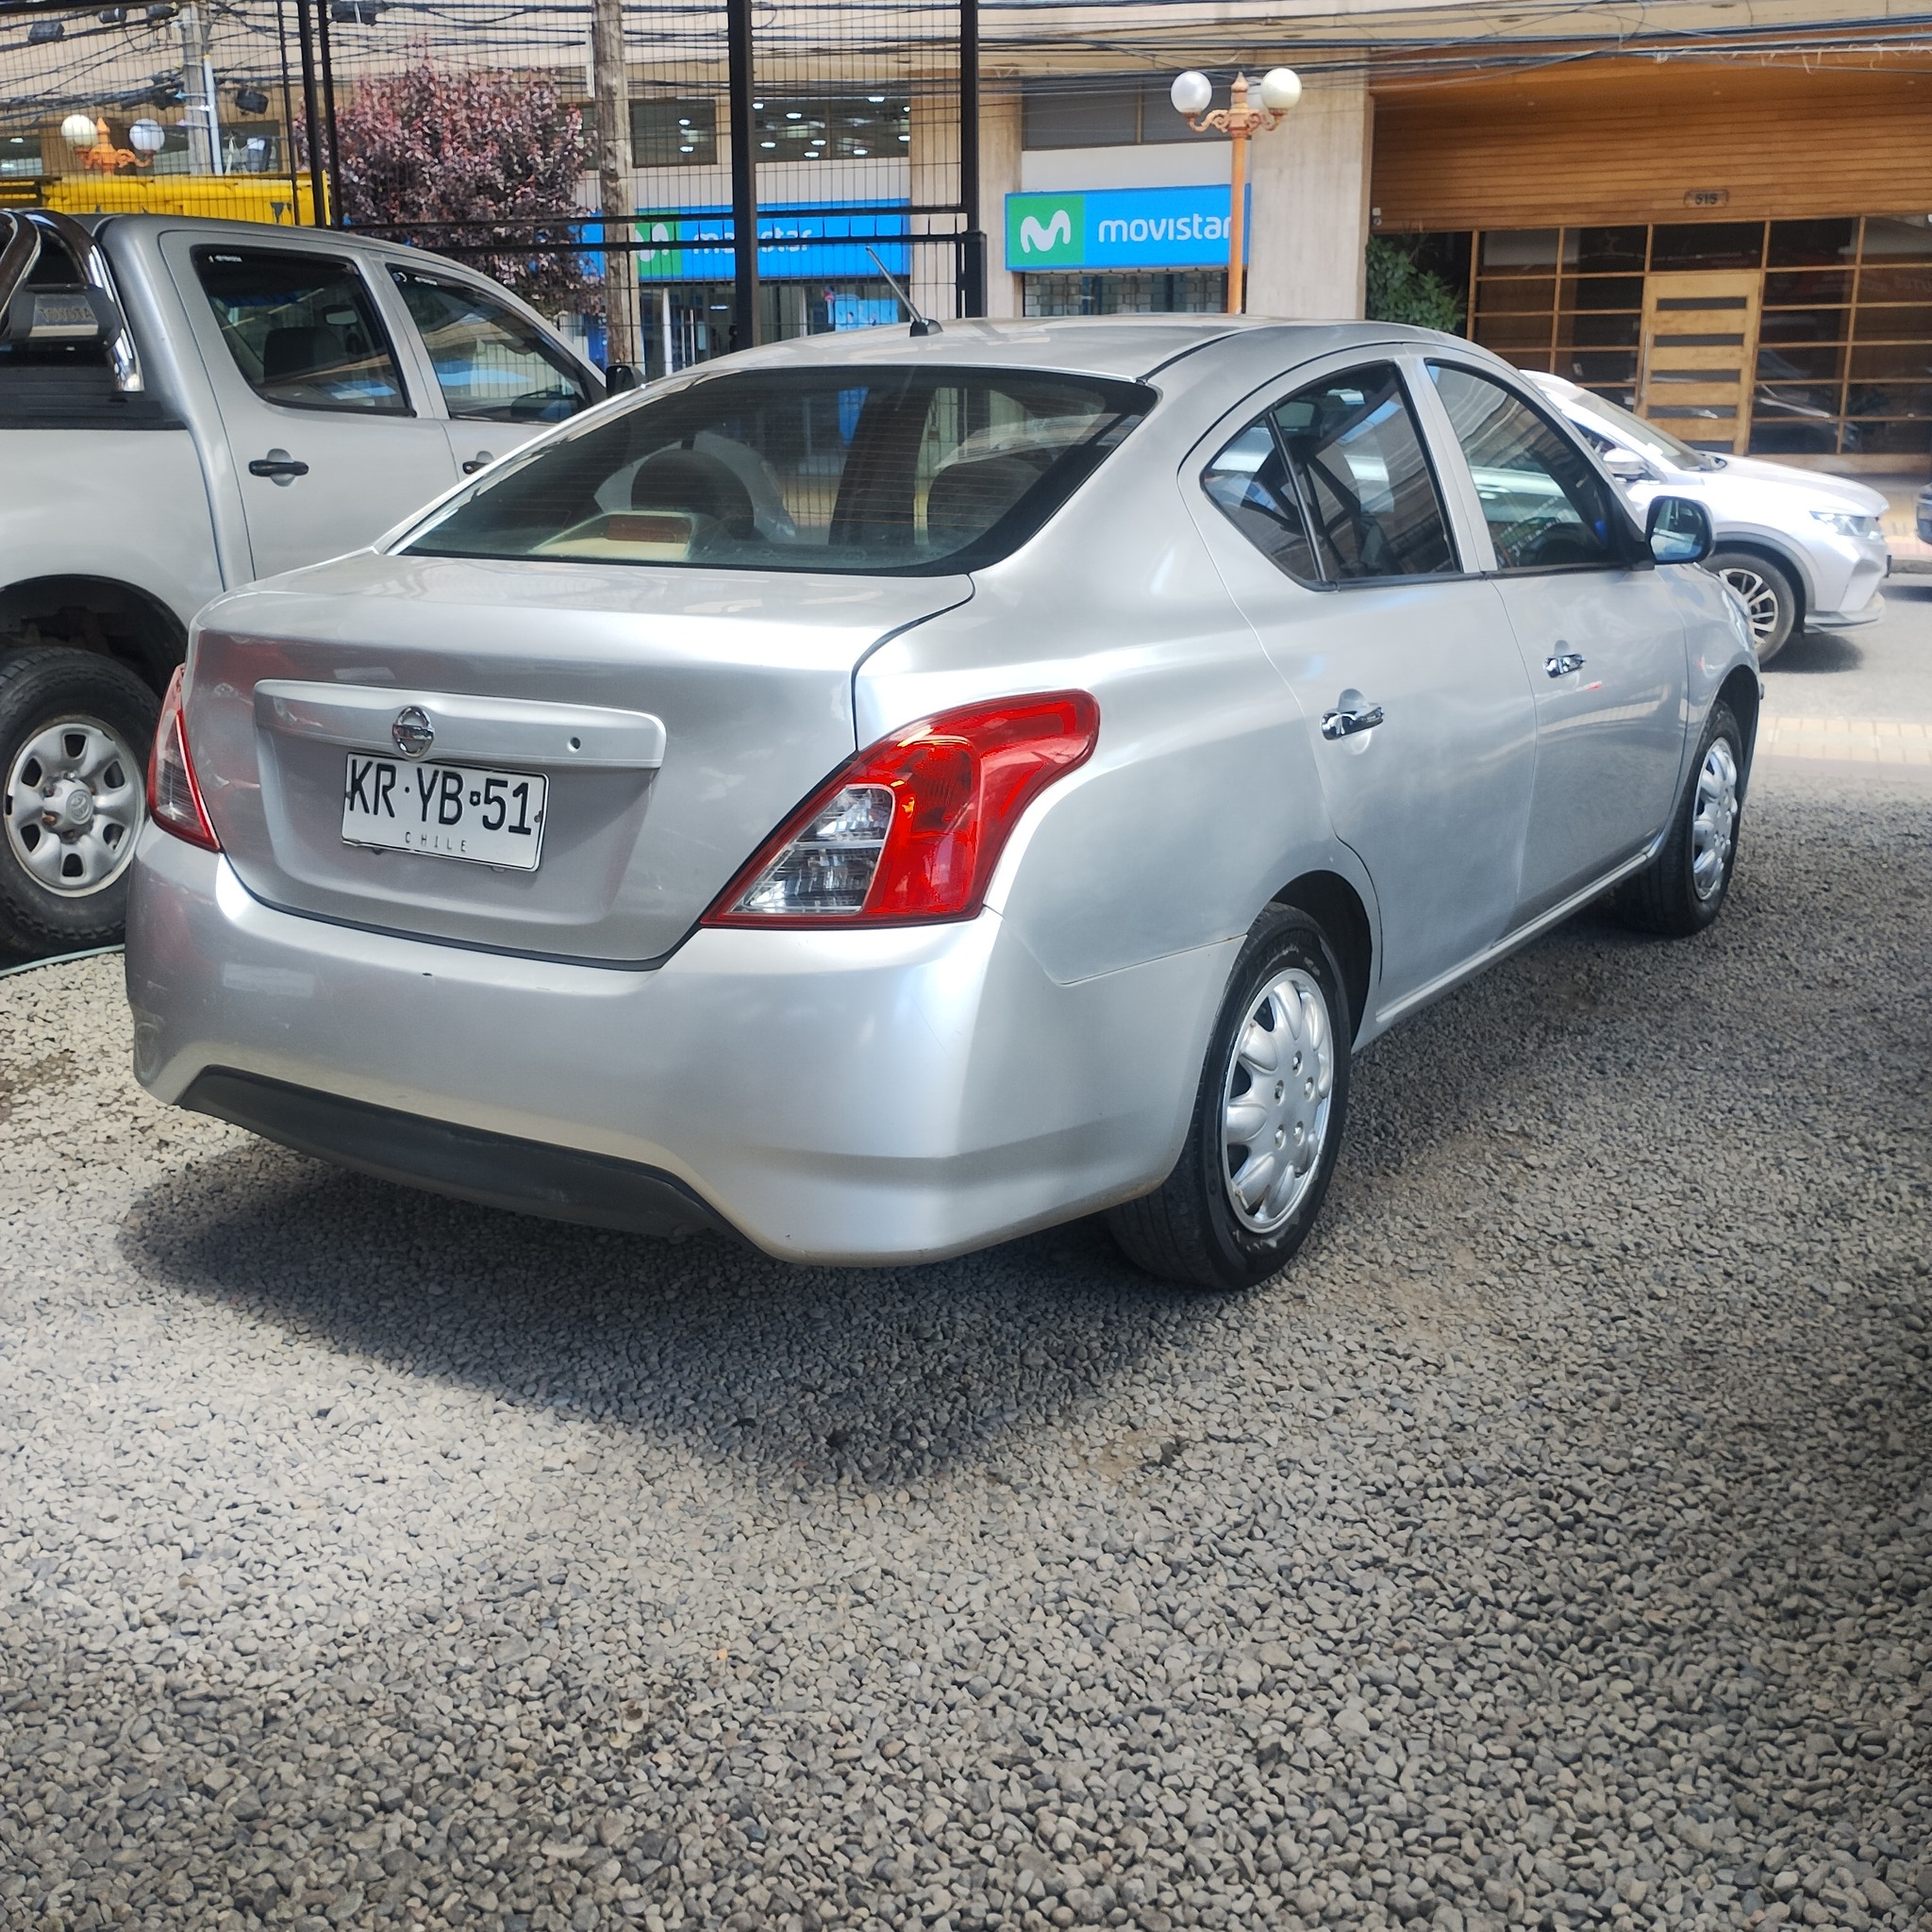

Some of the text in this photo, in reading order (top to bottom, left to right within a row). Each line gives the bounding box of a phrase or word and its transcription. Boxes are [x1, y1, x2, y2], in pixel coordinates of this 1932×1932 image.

[1694, 192, 1718, 205] 515
[693, 226, 813, 255] mostar
[1098, 213, 1231, 243] movistar
[405, 831, 467, 853] CHILE
